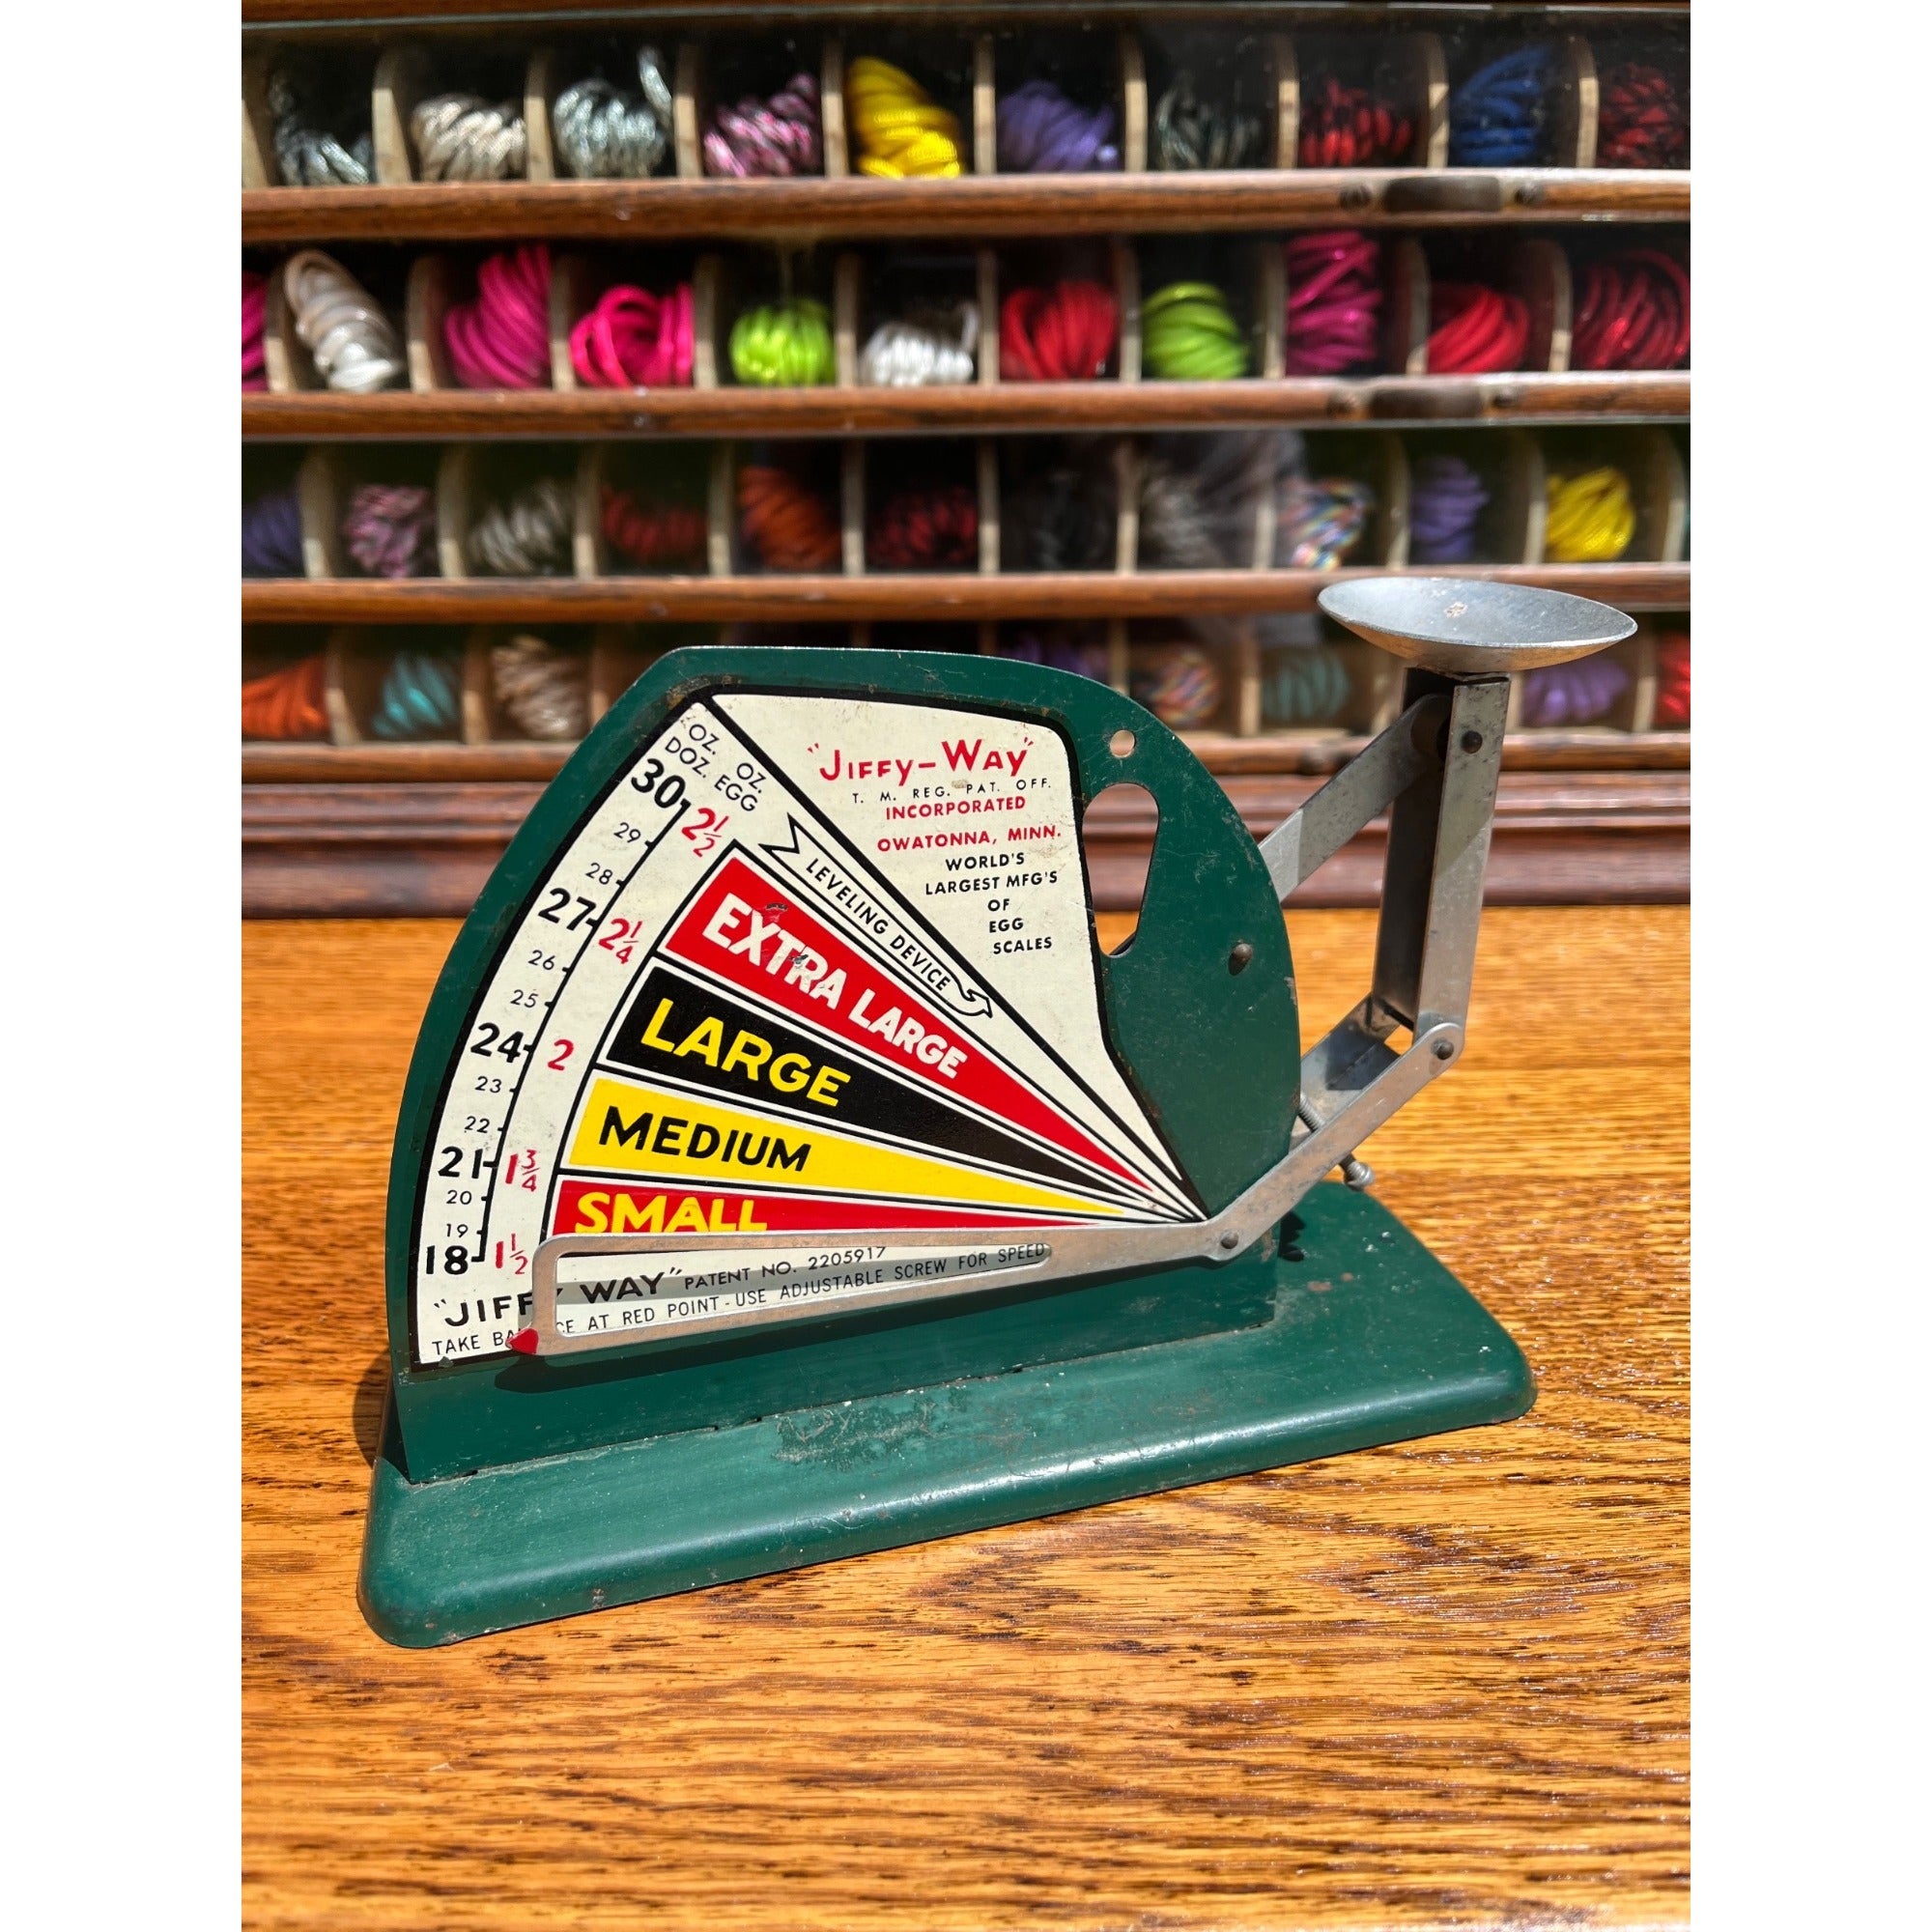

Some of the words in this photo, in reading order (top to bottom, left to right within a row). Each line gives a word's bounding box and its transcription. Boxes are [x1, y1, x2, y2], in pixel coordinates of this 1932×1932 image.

[689, 724, 720, 755] OZ.
[665, 737, 707, 779] DOZ.
[631, 758, 686, 809] 30
[736, 762, 766, 794] OZ.
[913, 786, 951, 799] REG.
[966, 781, 1000, 795] PAT.
[1016, 778, 1051, 791] OFF.
[714, 776, 758, 812] EGG
[885, 795, 1026, 820] INCORPORATED
[613, 822, 641, 843] 29
[877, 831, 998, 852] OWATONNA,
[1008, 825, 1062, 841] MINN.
[585, 863, 613, 885] 28
[945, 852, 1025, 871] WORLD'S
[924, 877, 1002, 895] LARGEST
[1006, 871, 1058, 888] MFG'S
[538, 888, 597, 931] 27
[987, 898, 1010, 912] OF
[806, 858, 888, 935] LEVELING
[890, 934, 951, 992] DEVICE
[988, 918, 1024, 933] EGG
[993, 936, 1053, 954] SCALES
[527, 950, 555, 971] 26
[510, 989, 538, 1009] 25
[702, 893, 847, 1010] EXTRA
[848, 988, 968, 1079] LARGE
[470, 1022, 525, 1064] 24
[547, 1038, 575, 1071] 2
[640, 998, 851, 1107] LARGE
[474, 1075, 502, 1094] 23
[465, 1116, 491, 1133] 22
[599, 1105, 812, 1173] MEDIUM
[438, 1146, 484, 1179] 21
[446, 1190, 473, 1206] 20
[575, 1191, 768, 1234] SMALL
[445, 1223, 469, 1238] 19
[425, 1244, 469, 1276] 18
[685, 1267, 752, 1291] PATENT
[761, 1261, 797, 1278] NO.
[808, 1245, 887, 1271] 2205917
[432, 1334, 482, 1355] TAKE
[587, 1314, 611, 1331] AT
[622, 1307, 656, 1325] RED
[780, 1269, 884, 1300] ADJUSTABLE
[895, 1259, 947, 1281] SCREW
[958, 1252, 988, 1270] FOR
[998, 1242, 1046, 1264] SPEED
